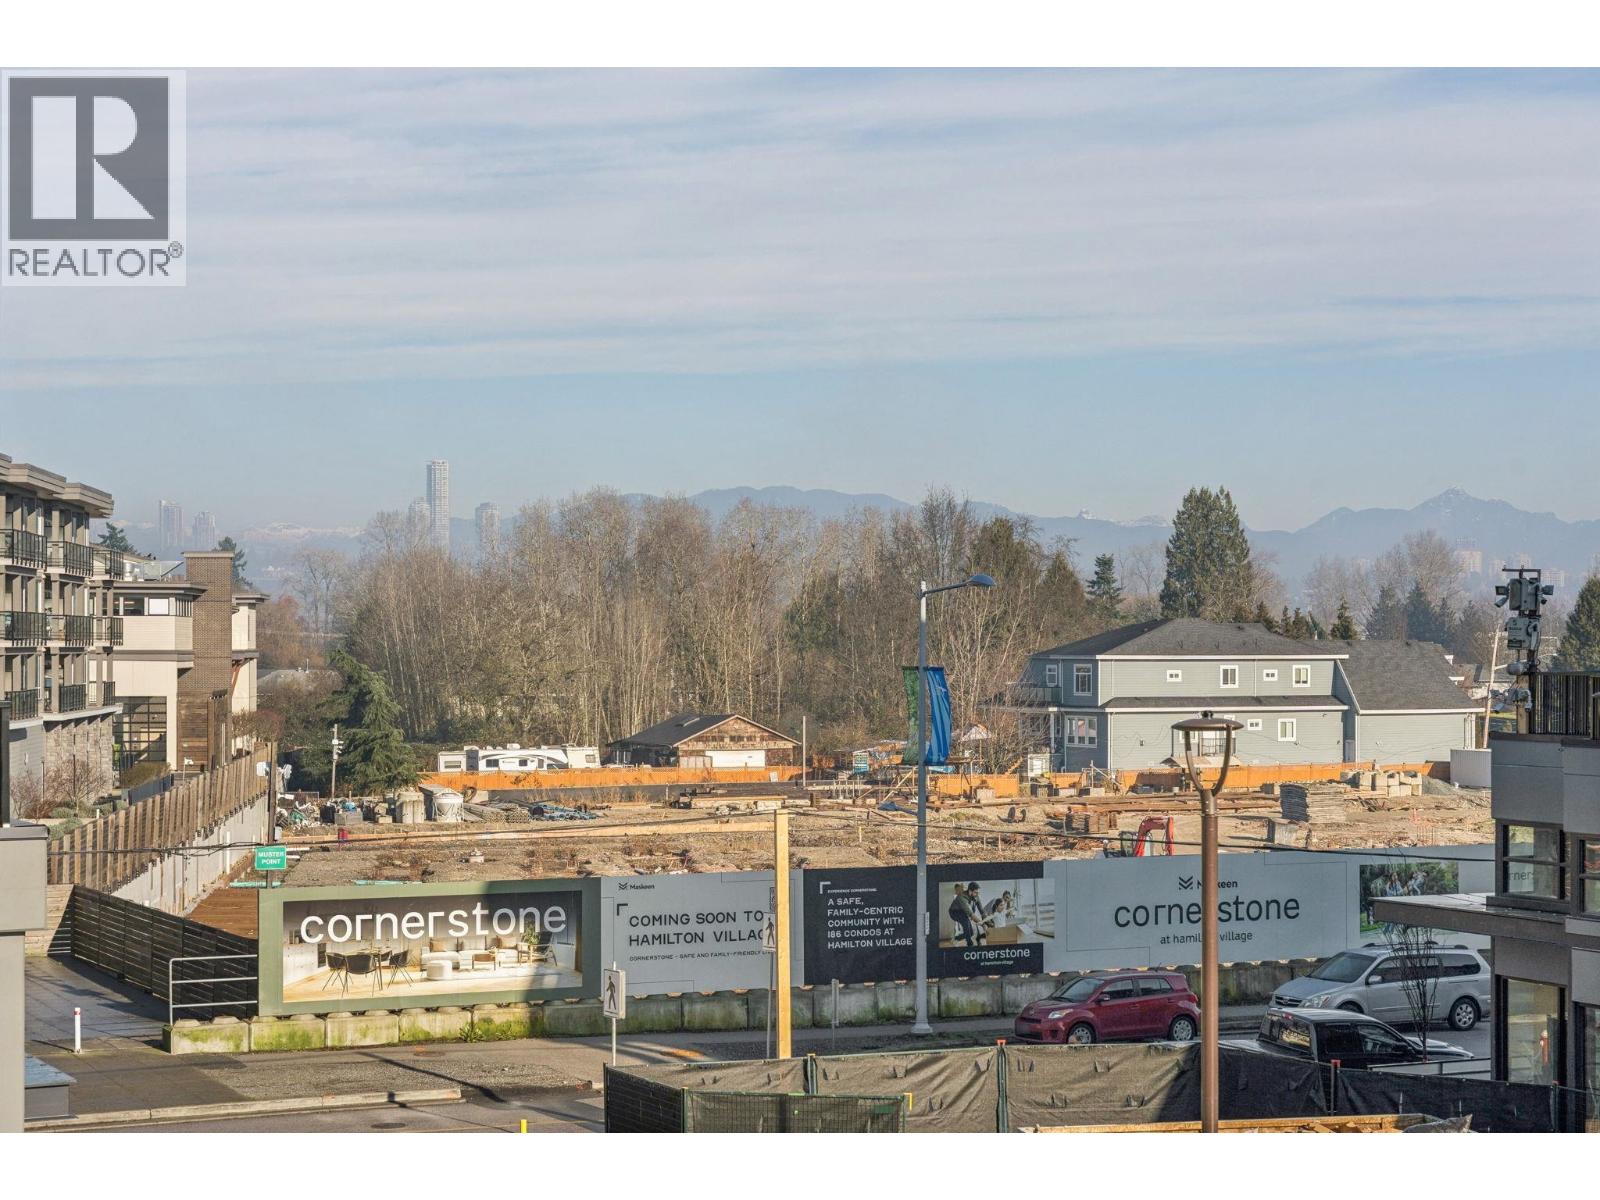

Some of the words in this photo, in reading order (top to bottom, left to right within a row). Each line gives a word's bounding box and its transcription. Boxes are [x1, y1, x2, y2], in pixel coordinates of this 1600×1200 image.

[836, 897, 864, 906] SAFE,
[828, 906, 904, 917] FAMILY-CENTRIC
[1114, 895, 1300, 928] cornestone
[300, 901, 567, 944] cornerstone
[629, 913, 691, 928] COMING
[696, 911, 736, 924] SOON
[744, 910, 764, 922] TO
[828, 918, 880, 928] COMMUNITY
[882, 916, 905, 925] WITH
[828, 930, 842, 938] 186
[844, 928, 882, 938] CONDOS
[884, 928, 895, 936] AT
[1160, 934, 1170, 944] at
[1173, 933, 1202, 944] hamil
[1220, 931, 1253, 942] village
[629, 932, 704, 947] HAMILTON
[828, 940, 873, 949] HAMILTON
[875, 938, 913, 946] VILLAGE
[964, 948, 1031, 960] cornerstone
